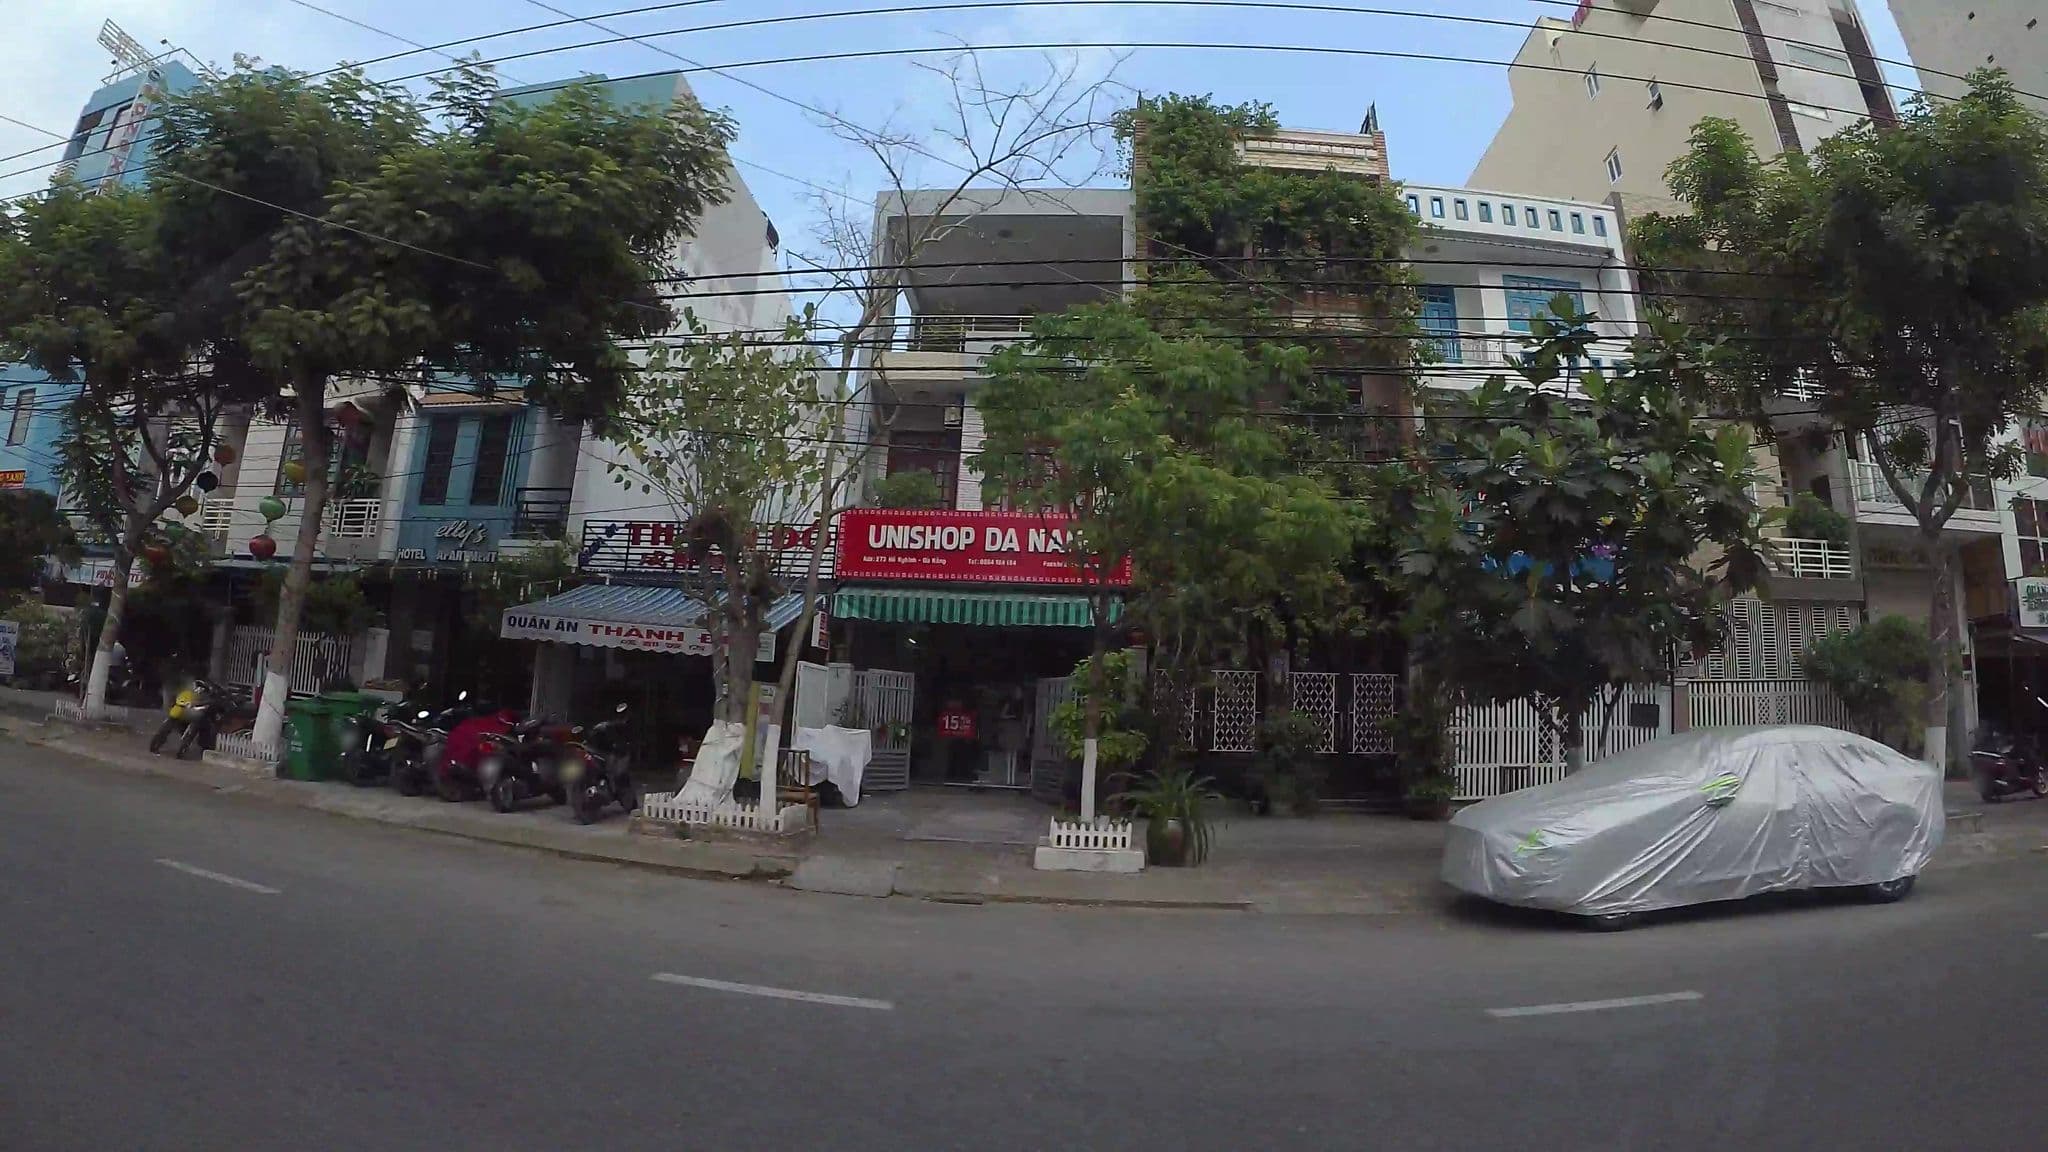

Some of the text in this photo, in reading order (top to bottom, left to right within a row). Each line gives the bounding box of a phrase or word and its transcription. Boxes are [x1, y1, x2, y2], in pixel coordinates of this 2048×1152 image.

[868, 524, 976, 551] UNISHOP
[984, 526, 1021, 553] DA
[397, 548, 426, 560] HOTEL
